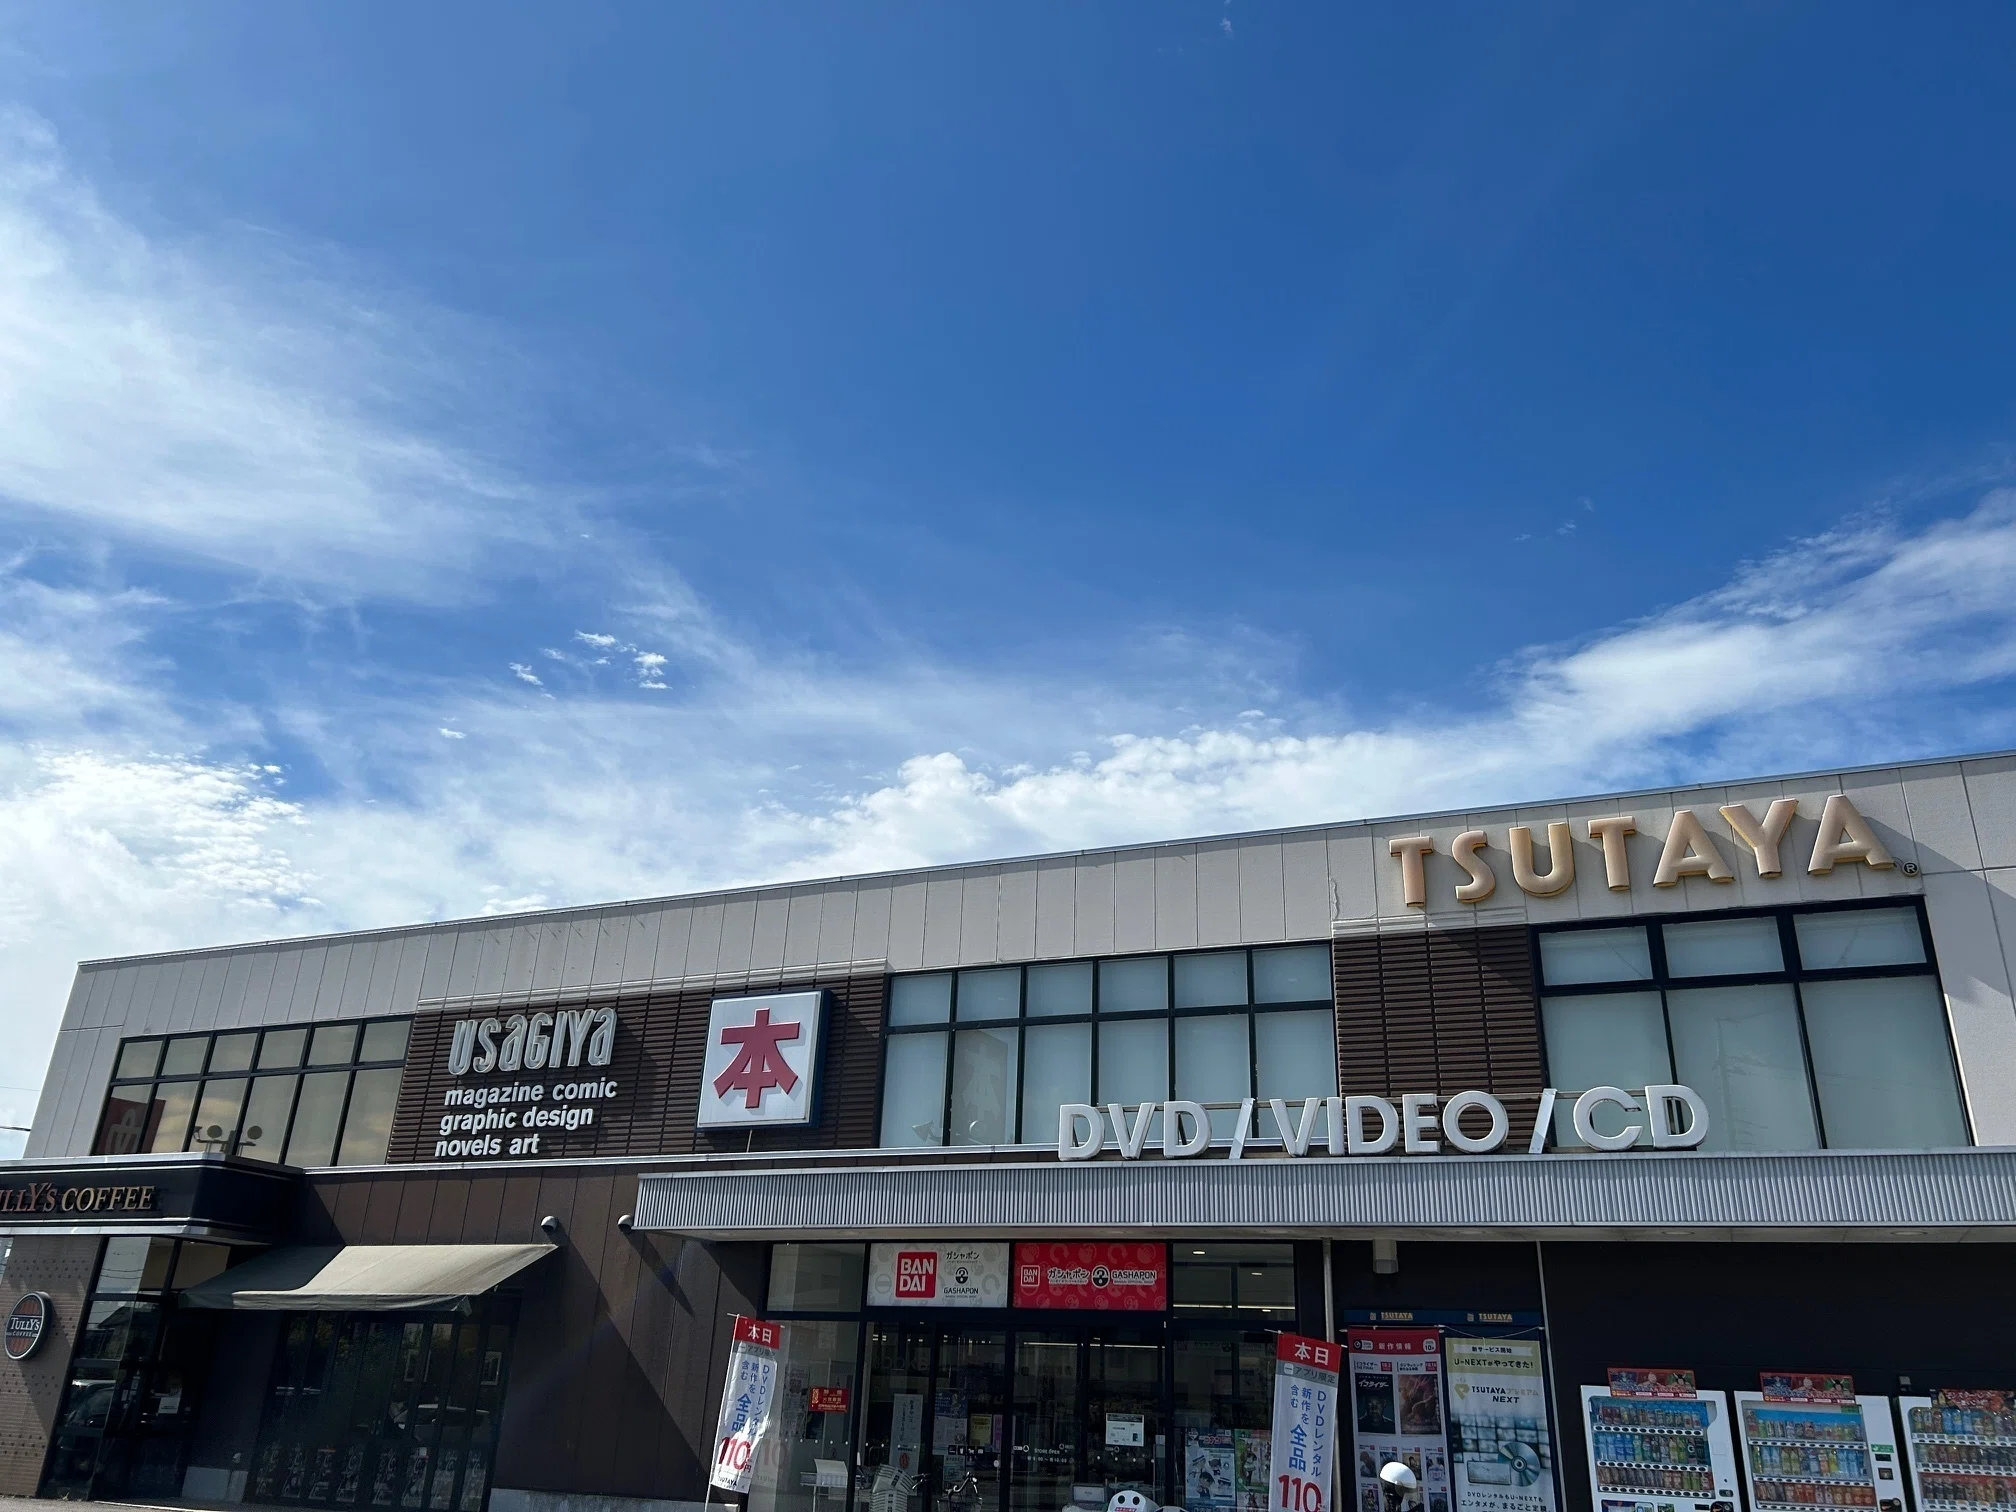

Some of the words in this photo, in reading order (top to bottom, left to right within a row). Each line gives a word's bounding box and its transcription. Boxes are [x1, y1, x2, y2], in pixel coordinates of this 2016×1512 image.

[1388, 794, 1898, 908] TSUTAYA
[712, 1007, 801, 1109] 本
[444, 1081, 545, 1109] magazine
[552, 1076, 618, 1101] comic
[439, 1107, 518, 1136] graphic
[522, 1105, 594, 1131] design
[1058, 1100, 1212, 1161] DVD
[1269, 1090, 1510, 1157] VIDEO
[1573, 1084, 1710, 1152] CD
[434, 1134, 502, 1157] novels
[508, 1133, 540, 1155] art
[61, 1185, 156, 1212] COFFEE
[1047, 1267, 1090, 1279] ガシャポン
[1112, 1270, 1156, 1280] GASHAPON
[943, 1286, 979, 1295] GASHAPON
[748, 1324, 772, 1344] 本日
[1294, 1342, 1329, 1366] 本日
[1294, 1365, 1336, 1384] アプリ限定
[1290, 1384, 1300, 1409] 含む
[1300, 1387, 1312, 1425] 新作を
[1492, 1395, 1520, 1404] NEXT
[1310, 1390, 1327, 1477] DVDレンタル
[1288, 1423, 1307, 1473] 全品
[1278, 1474, 1322, 1512] 110
